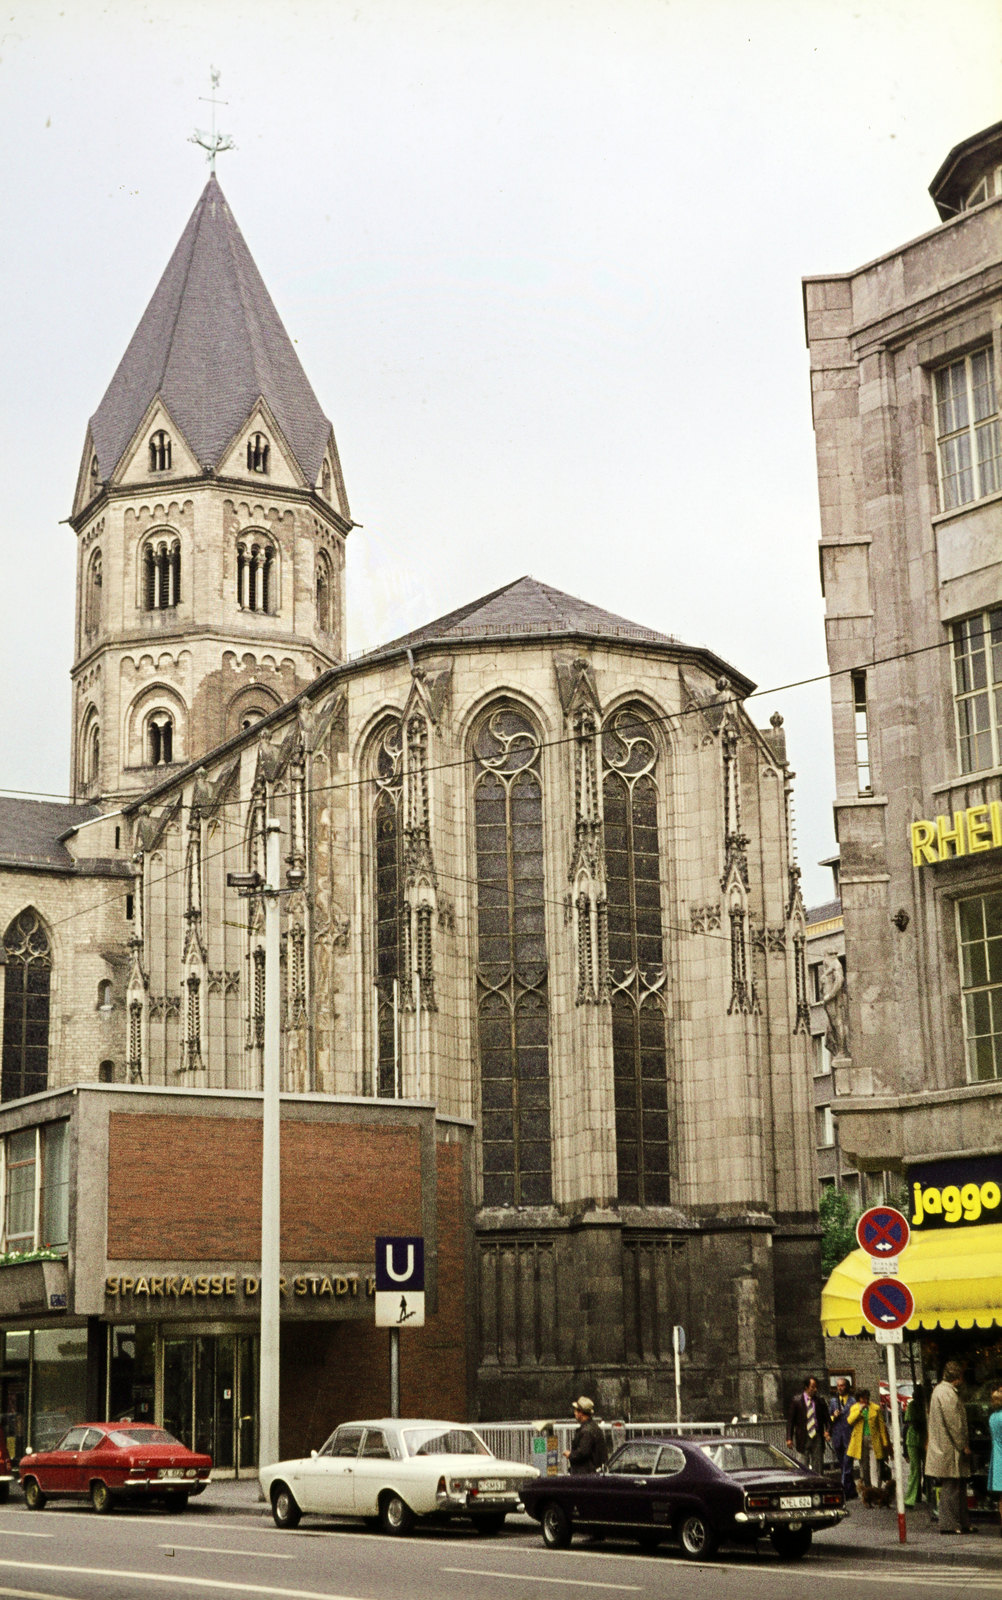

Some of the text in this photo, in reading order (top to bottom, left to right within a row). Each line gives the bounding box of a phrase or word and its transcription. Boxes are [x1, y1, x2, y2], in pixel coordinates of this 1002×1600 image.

[912, 1181, 1001, 1225] jaggo
[386, 1244, 414, 1282] U
[106, 1276, 236, 1295] SPARKASSE
[245, 1277, 288, 1295] DR
[294, 1277, 360, 1295] STADT
